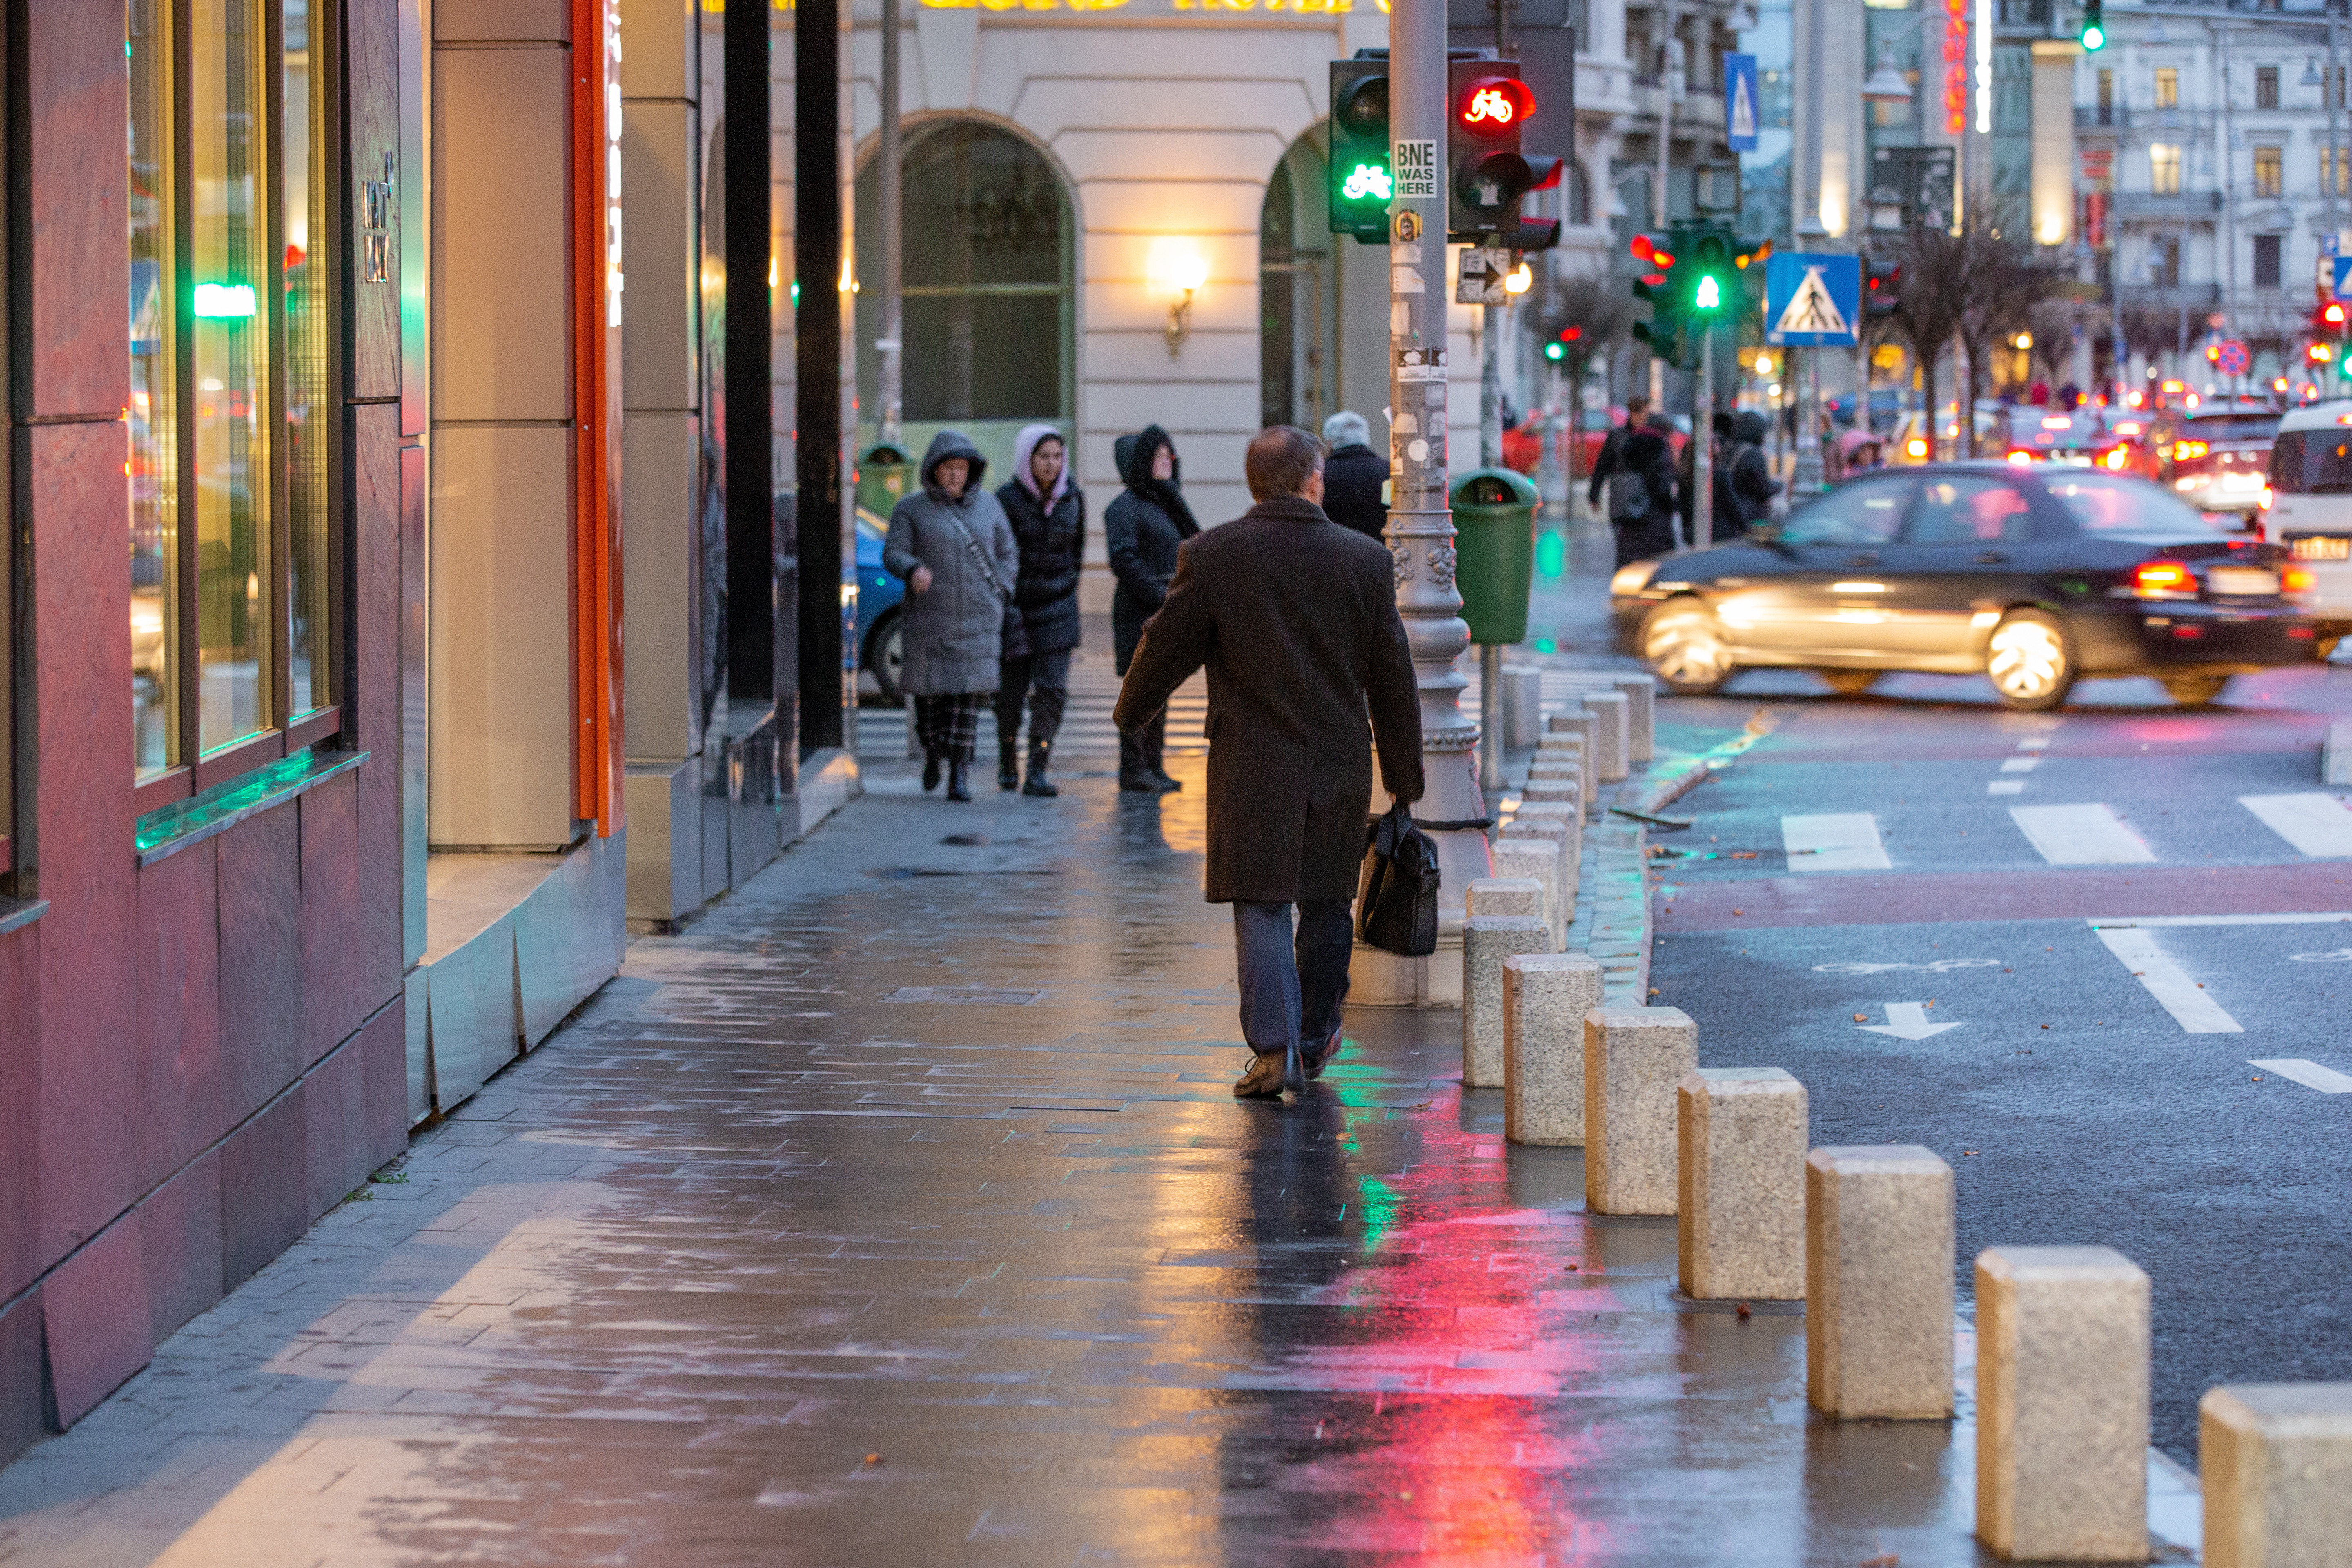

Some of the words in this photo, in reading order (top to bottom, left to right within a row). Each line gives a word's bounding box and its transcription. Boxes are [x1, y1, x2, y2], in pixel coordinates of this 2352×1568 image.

[1398, 144, 1434, 166] BNE
[1398, 168, 1434, 180] WAS
[1398, 183, 1434, 194] HERE
